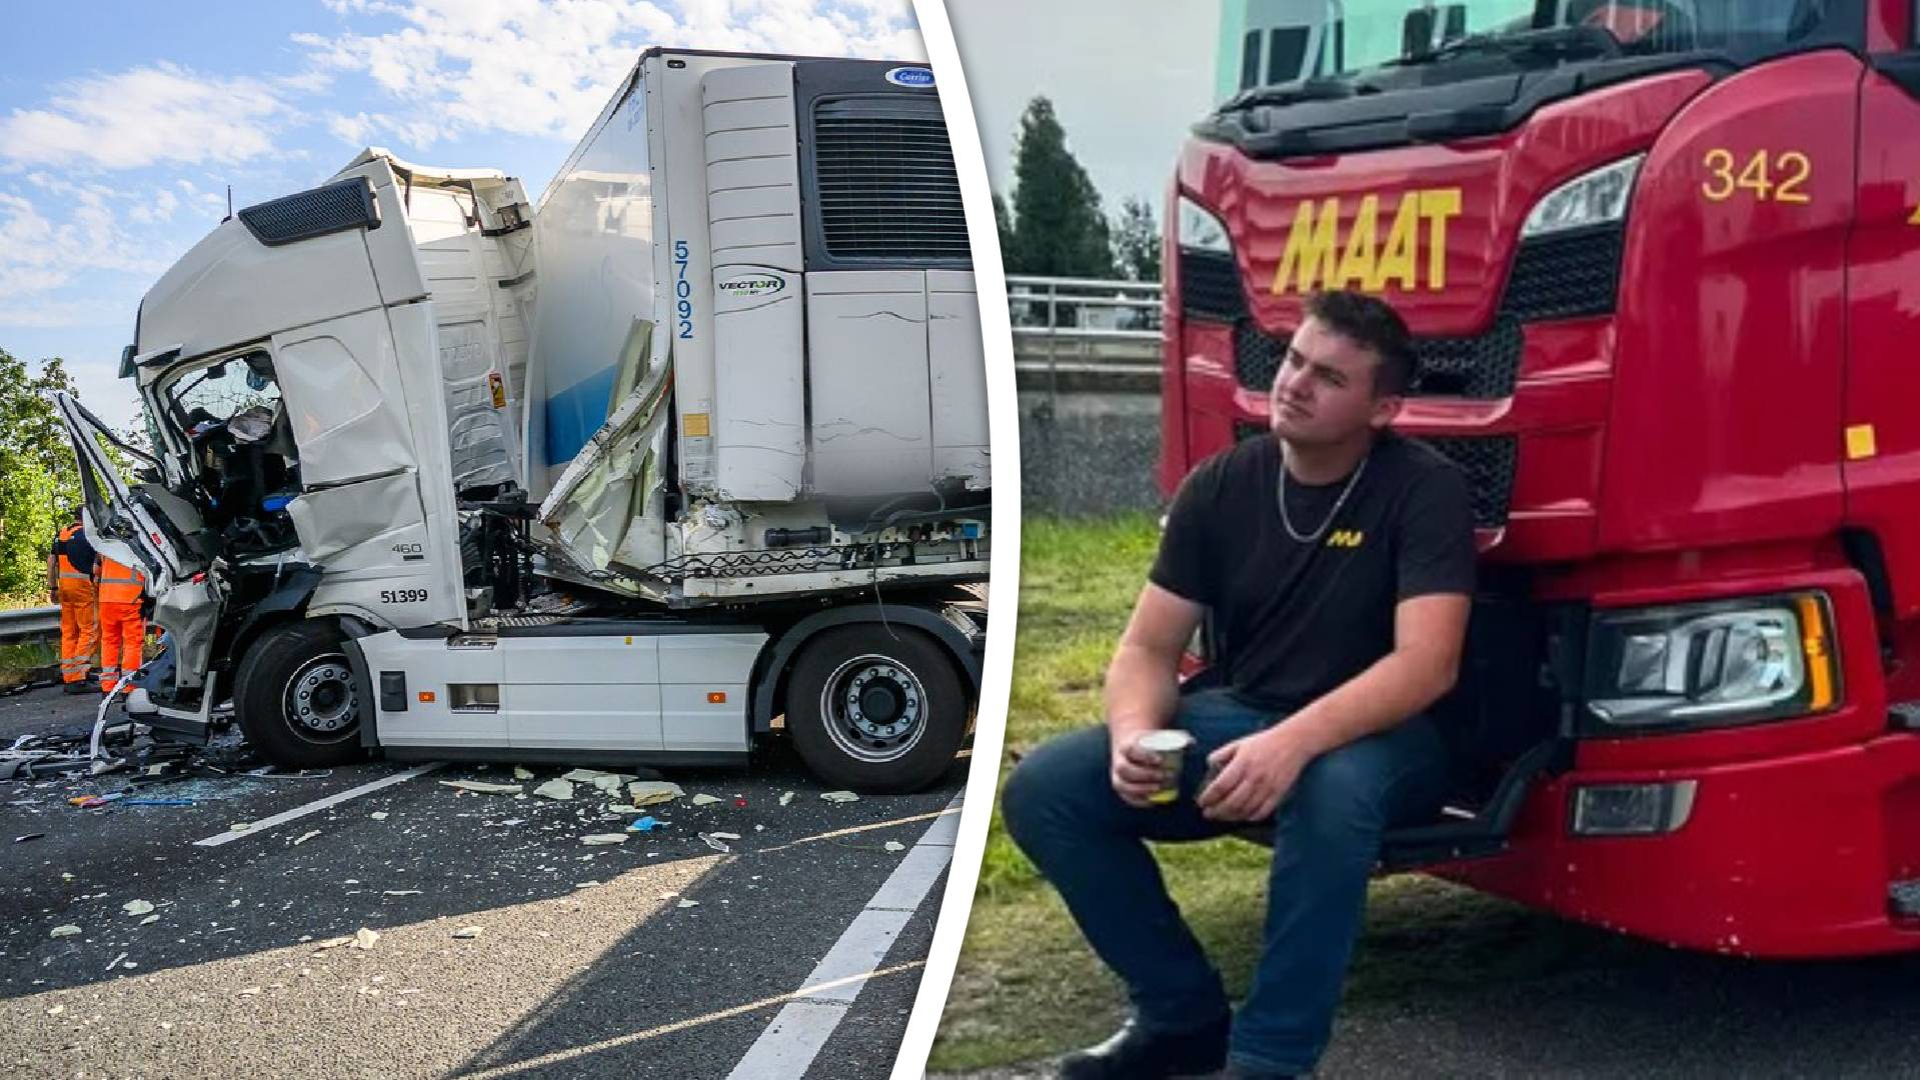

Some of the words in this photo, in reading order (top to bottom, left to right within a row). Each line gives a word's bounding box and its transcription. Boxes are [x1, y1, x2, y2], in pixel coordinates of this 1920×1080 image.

[1702, 148, 1811, 202] 342
[1272, 187, 1462, 294] MAAT
[675, 240, 693, 339] 57092
[719, 280, 778, 290] VECTOR
[392, 543, 422, 554] 460
[381, 589, 428, 603] 51399
